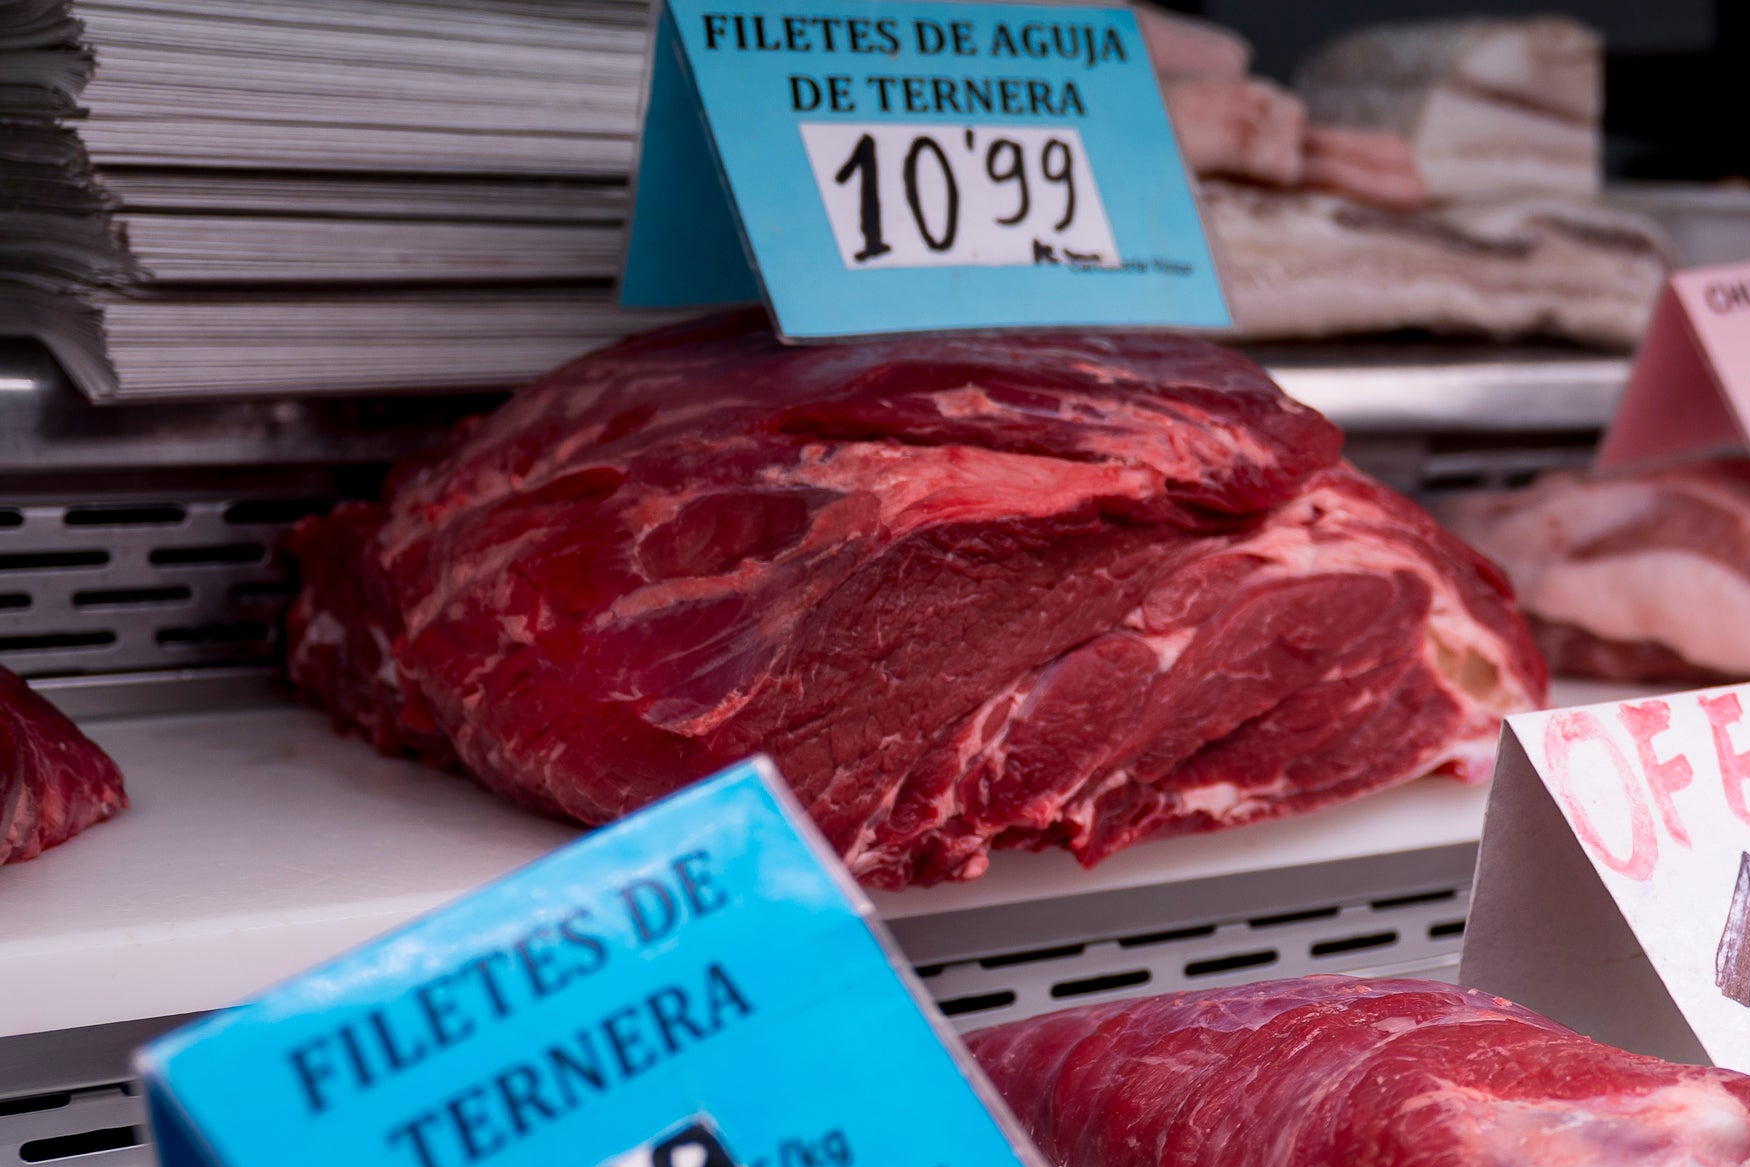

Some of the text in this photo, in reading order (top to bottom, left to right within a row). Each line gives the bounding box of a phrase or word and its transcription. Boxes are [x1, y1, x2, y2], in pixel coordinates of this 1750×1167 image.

[702, 14, 1129, 67] FILETES DE AGUJA
[787, 75, 1087, 117] DE TERNERA
[285, 849, 731, 1117] FILETES DE
